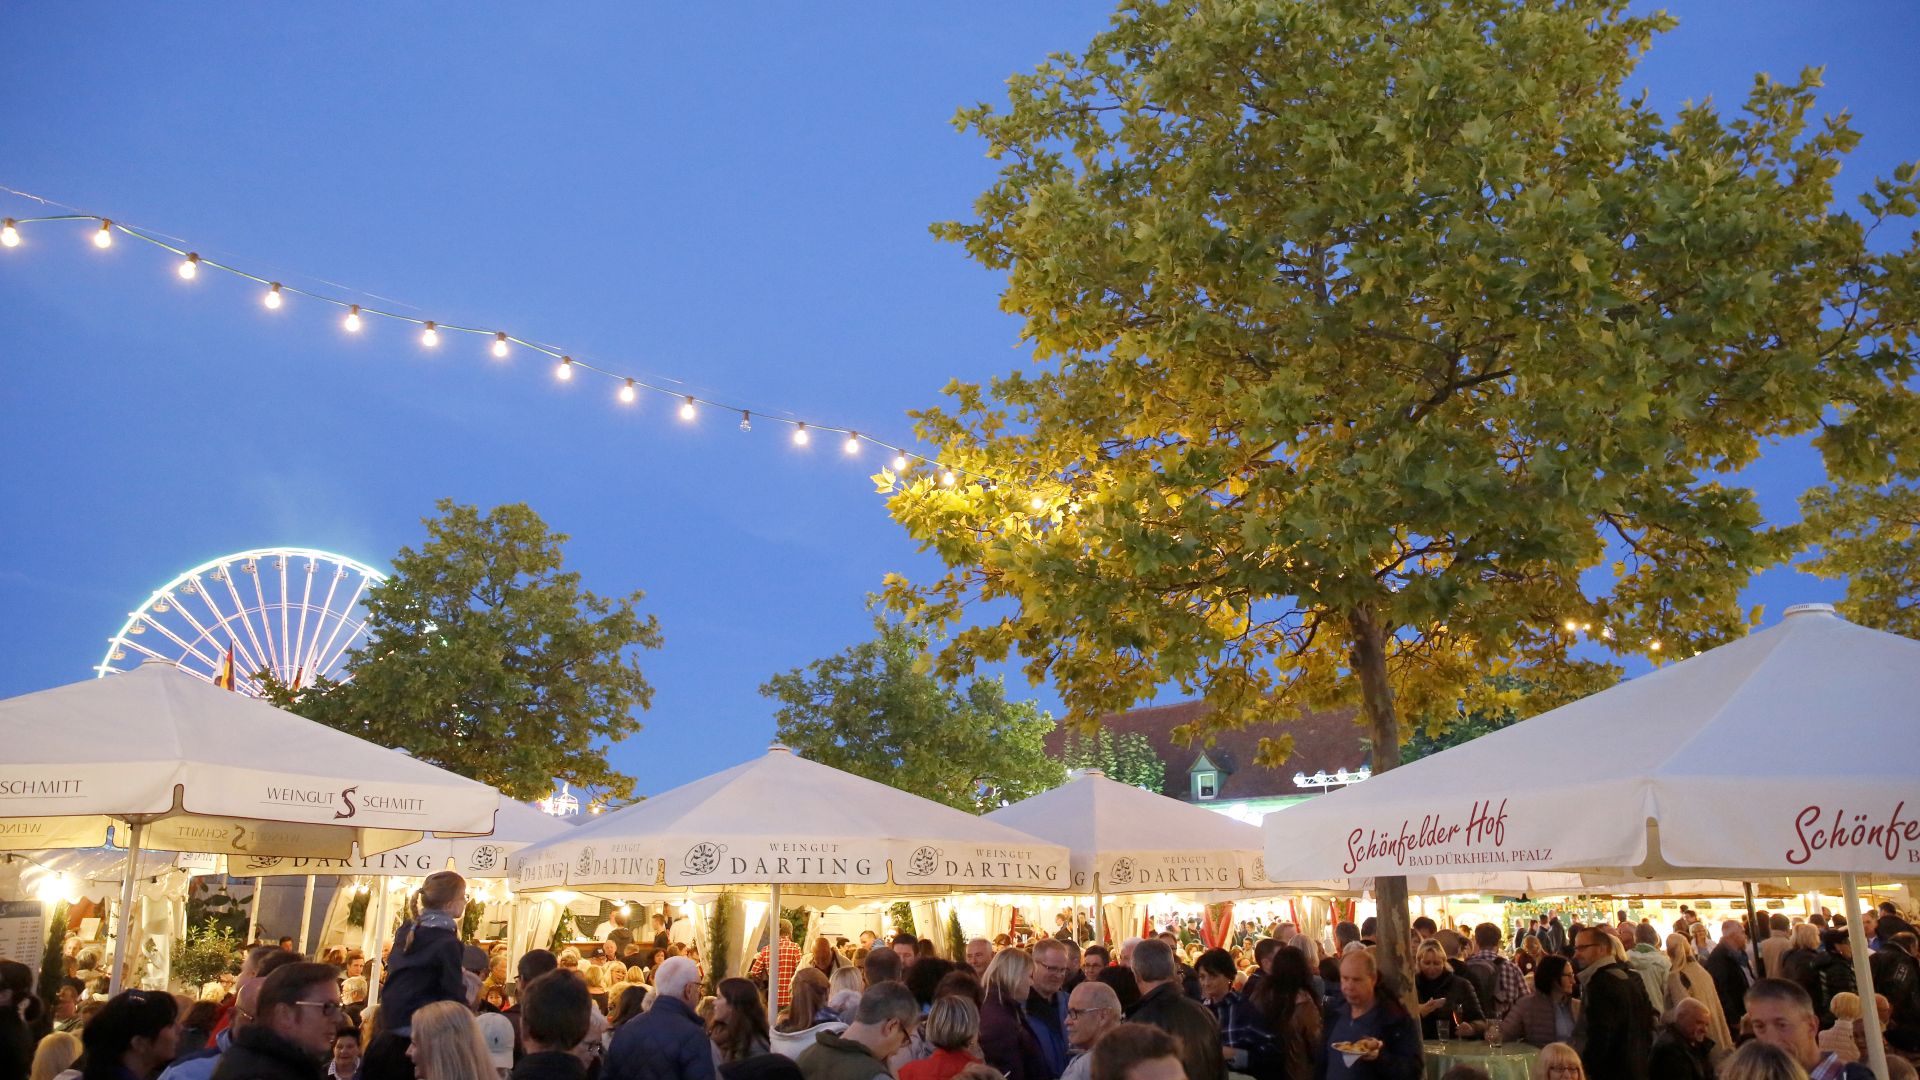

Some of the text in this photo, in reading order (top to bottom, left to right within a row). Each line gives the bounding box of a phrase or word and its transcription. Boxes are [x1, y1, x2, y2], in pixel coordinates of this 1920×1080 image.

[0, 779, 83, 795] SCHMITT
[267, 787, 336, 805] WEINGUT
[363, 795, 425, 811] SCHMITT
[1343, 798, 1508, 874] Schönfelder Hof
[1786, 801, 1920, 865] Schönfe
[769, 843, 840, 853] WEINGUT
[976, 849, 1033, 860] WEINGUT
[593, 857, 655, 876] DARTING
[731, 857, 872, 876] DARTING
[1163, 856, 1208, 865] WEINGUT
[1409, 849, 1553, 867] BAD DÜRKHEIM, PFALZ
[946, 860, 1058, 882] DARTING
[1140, 866, 1229, 884] DARTING
